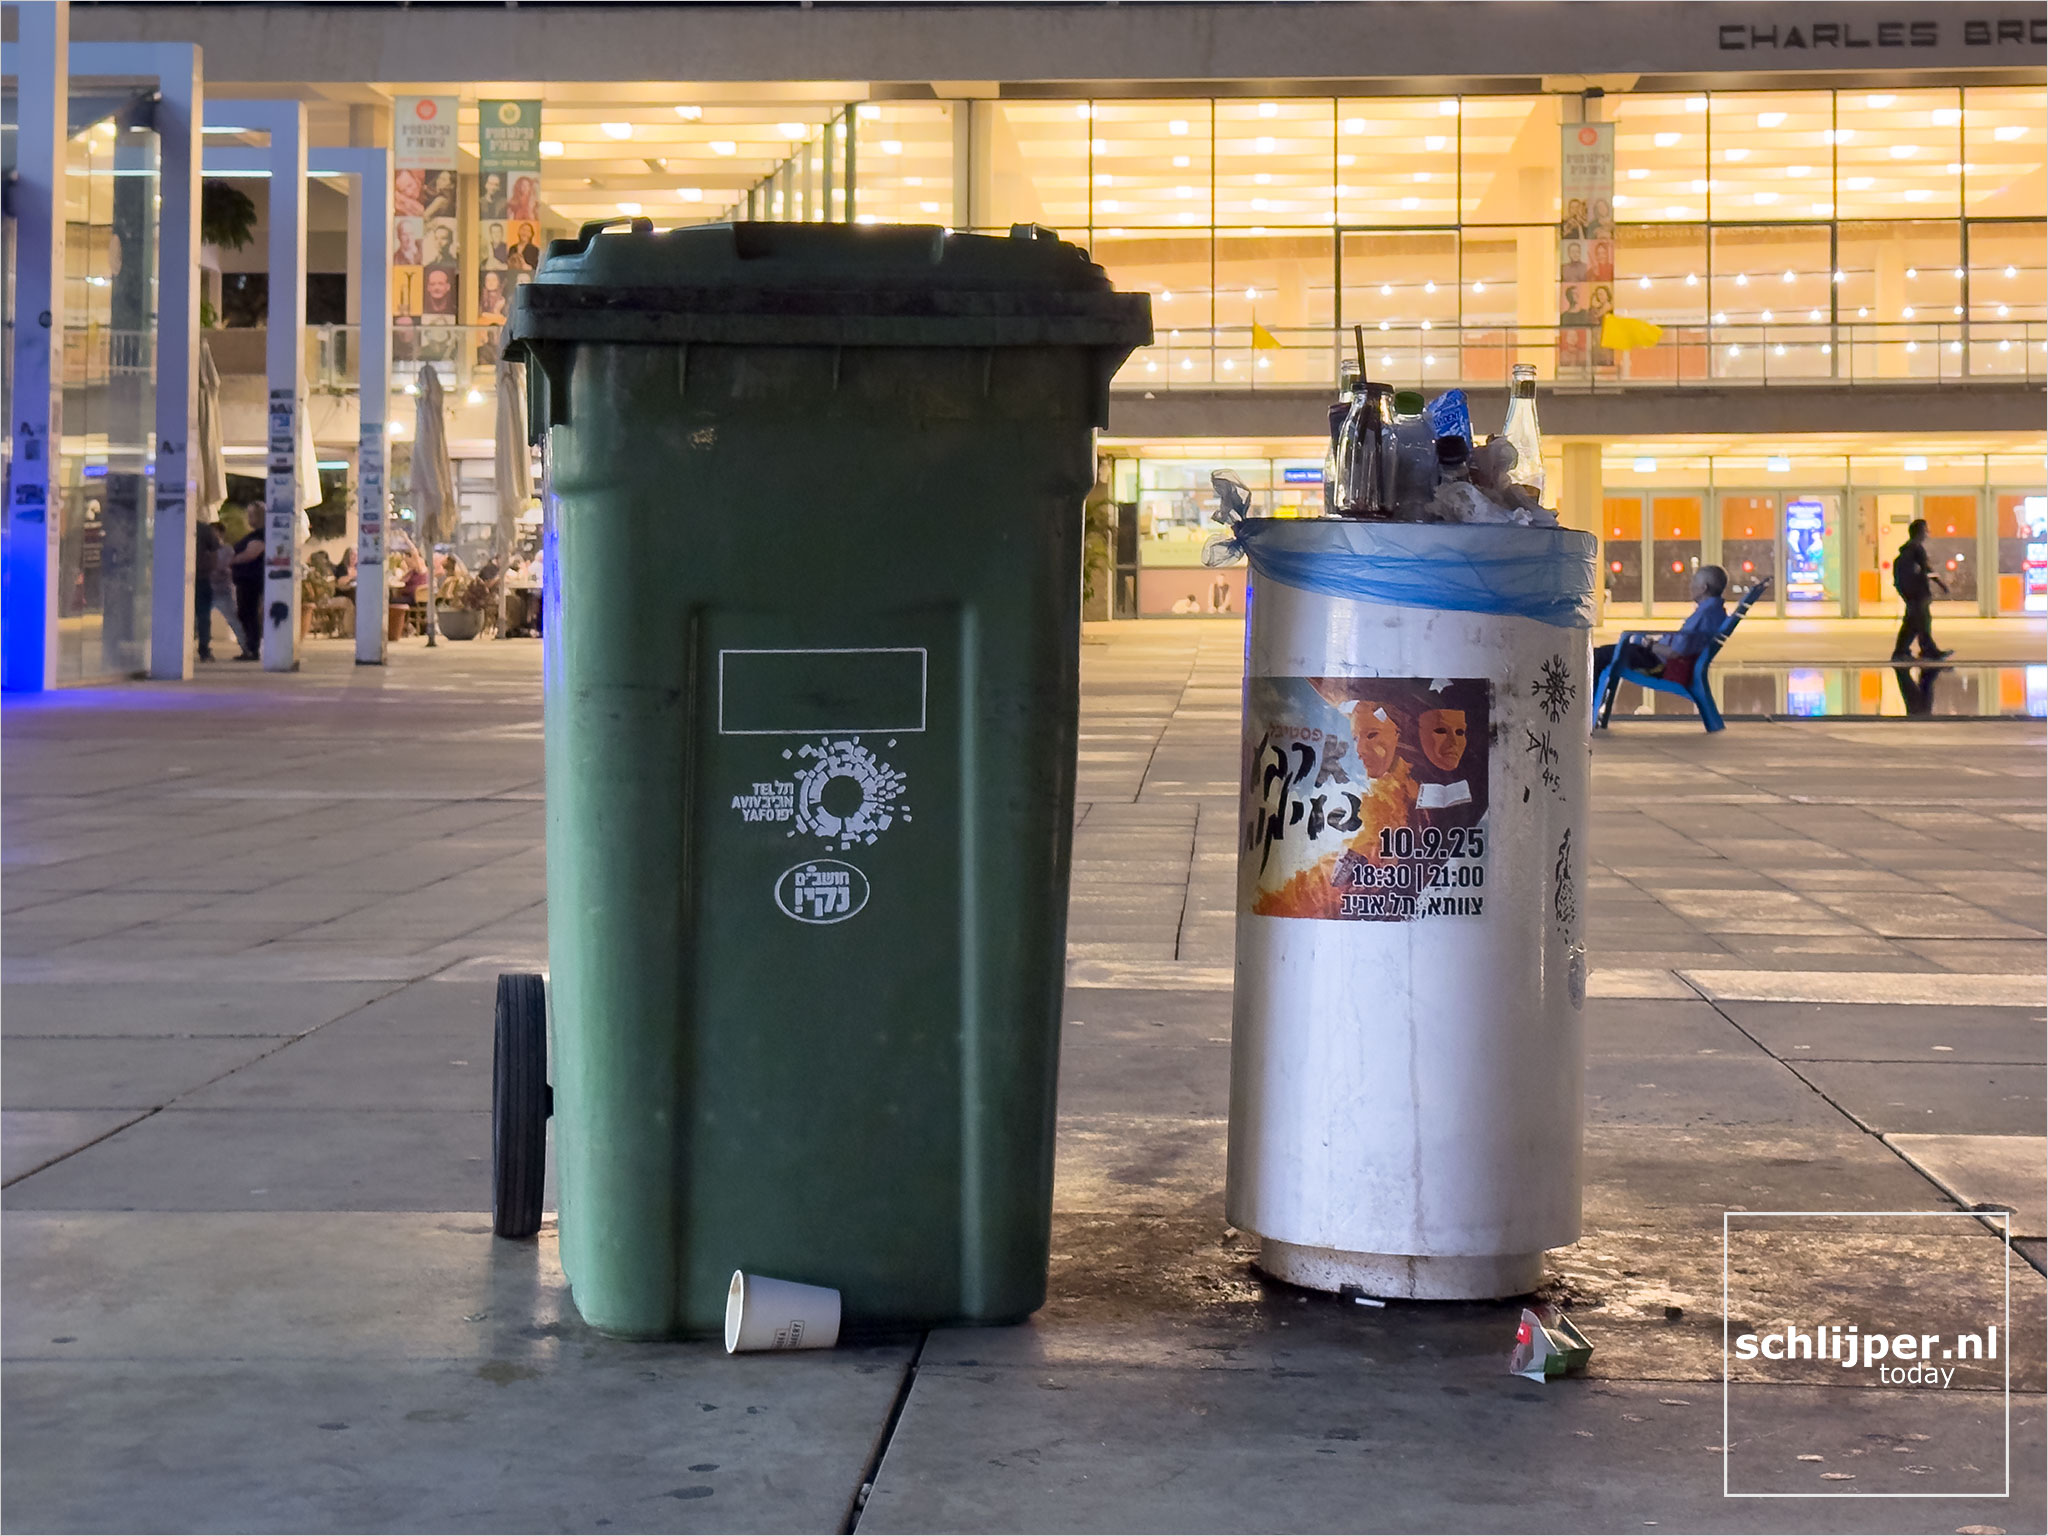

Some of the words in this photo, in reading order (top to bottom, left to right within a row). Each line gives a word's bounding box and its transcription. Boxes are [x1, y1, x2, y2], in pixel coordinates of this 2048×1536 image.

[1719, 21, 1939, 50] CHARLES
[752, 783, 775, 796] TEL
[774, 780, 794, 796] תל
[731, 795, 761, 809] AVIV
[761, 795, 794, 809] אביב
[741, 808, 775, 822] YAFO
[775, 808, 794, 822] יפו
[1379, 827, 1484, 859] 10.9.25
[1352, 864, 1411, 888] 18:30
[1428, 865, 1484, 888] 21:00
[1341, 894, 1385, 915] אביב
[1389, 893, 1416, 917] תל
